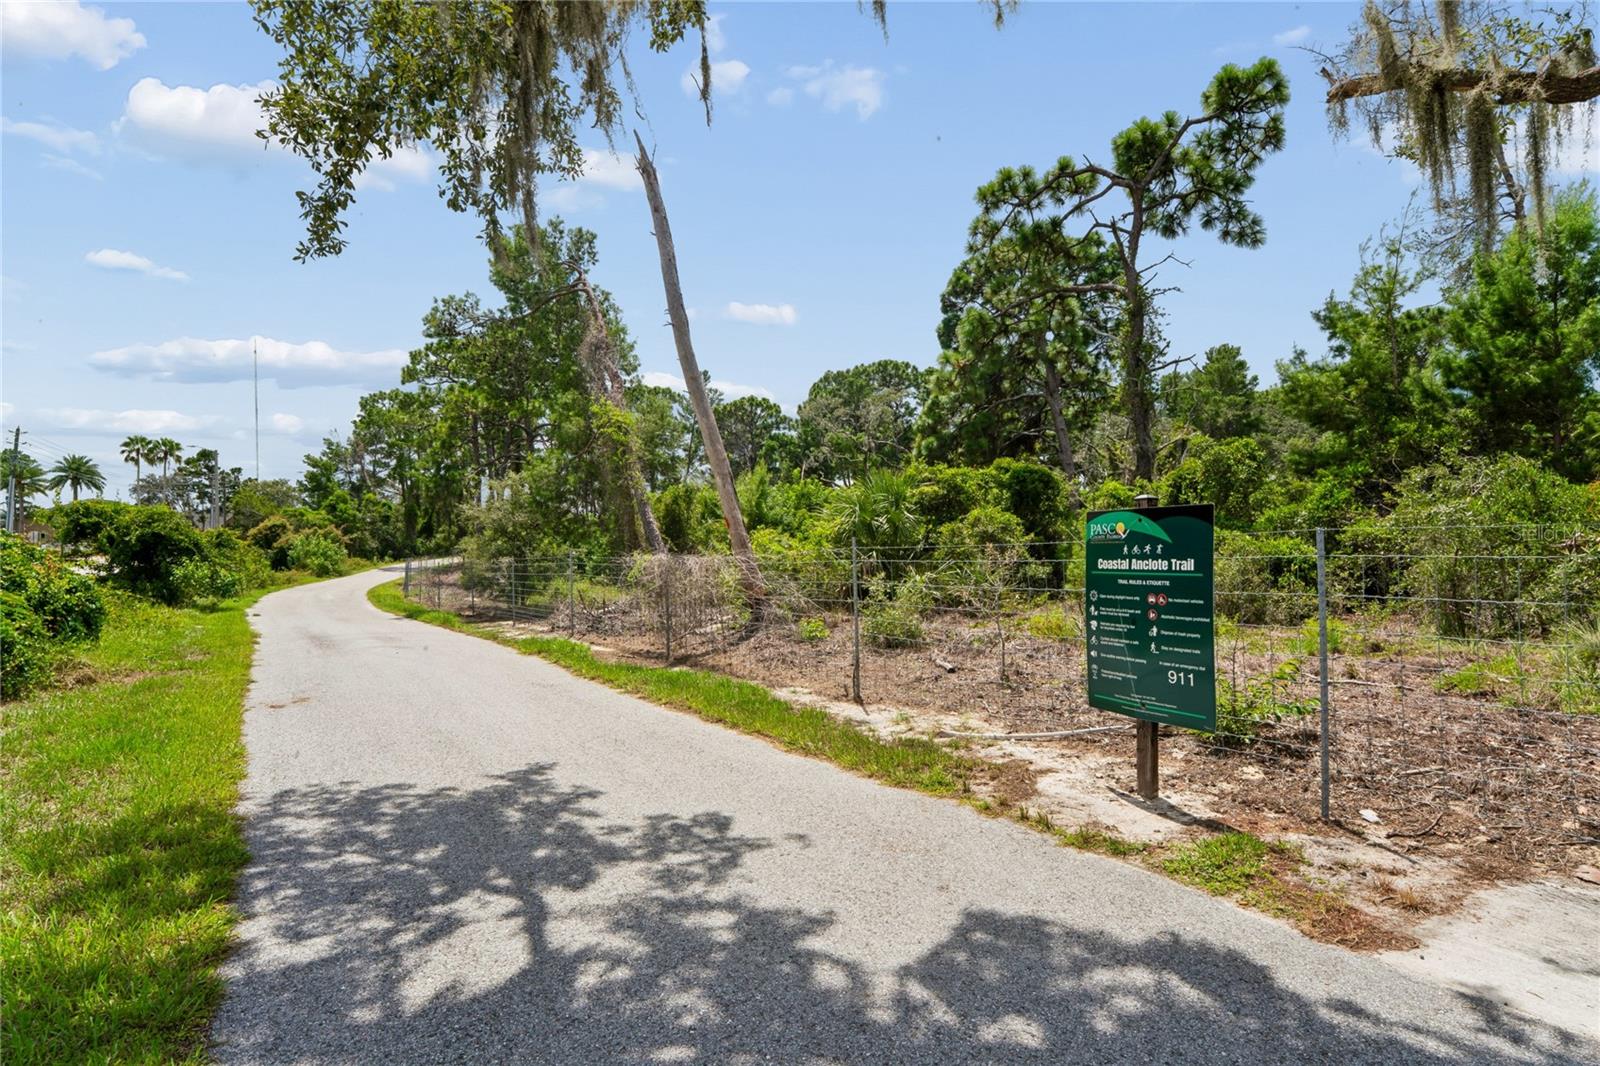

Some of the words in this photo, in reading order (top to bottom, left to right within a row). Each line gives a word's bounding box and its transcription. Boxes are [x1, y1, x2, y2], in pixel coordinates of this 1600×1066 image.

[1097, 558, 1129, 570] Coastal
[1131, 559, 1168, 571] Anclote
[1171, 559, 1195, 571] Trail
[1168, 670, 1194, 687] 911
